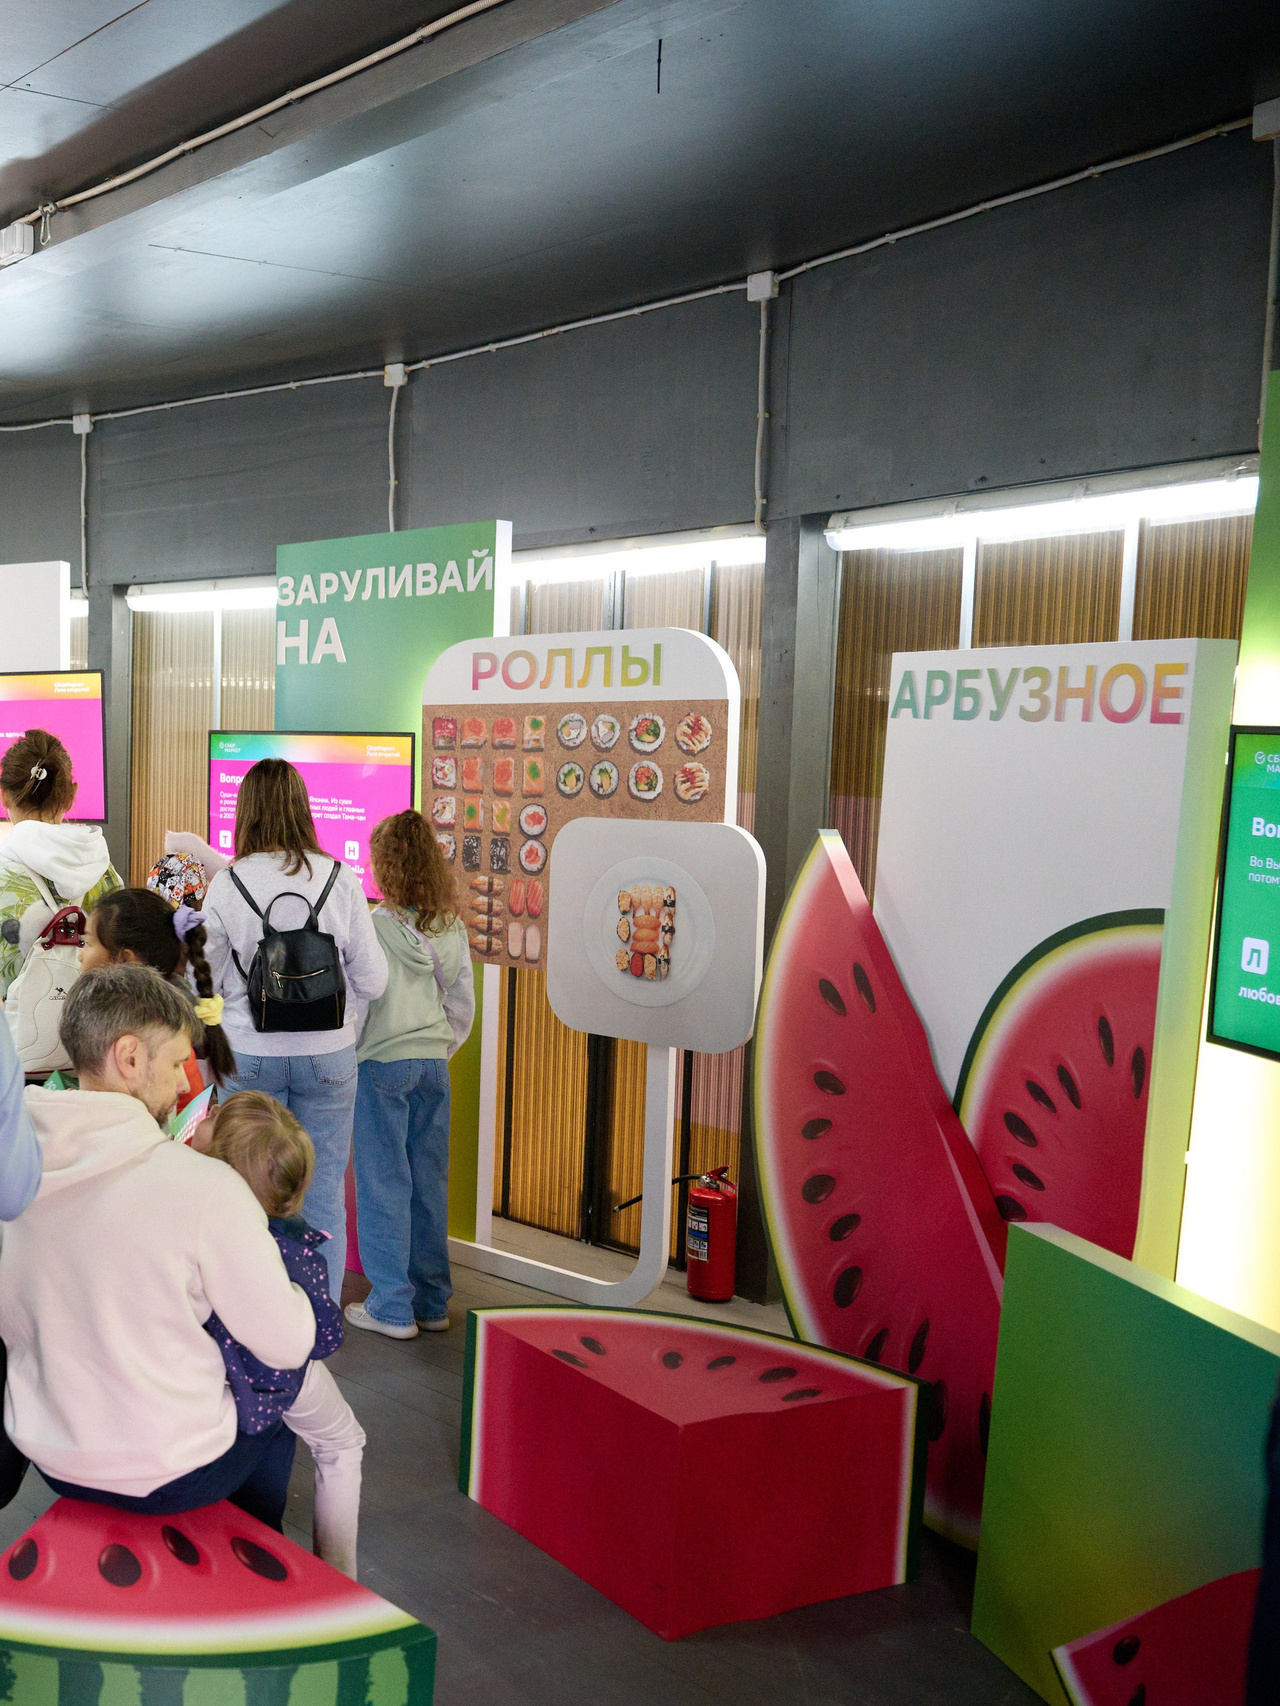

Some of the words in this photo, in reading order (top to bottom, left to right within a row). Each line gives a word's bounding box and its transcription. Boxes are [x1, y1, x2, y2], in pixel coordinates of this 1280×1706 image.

[276, 548, 494, 607] ЗАРУЛИВАЙ
[276, 617, 347, 665] НА
[472, 643, 662, 690] РОЛЛЫ
[890, 662, 1187, 724] АРБУЗНОЕ
[1249, 855, 1264, 868] Во
